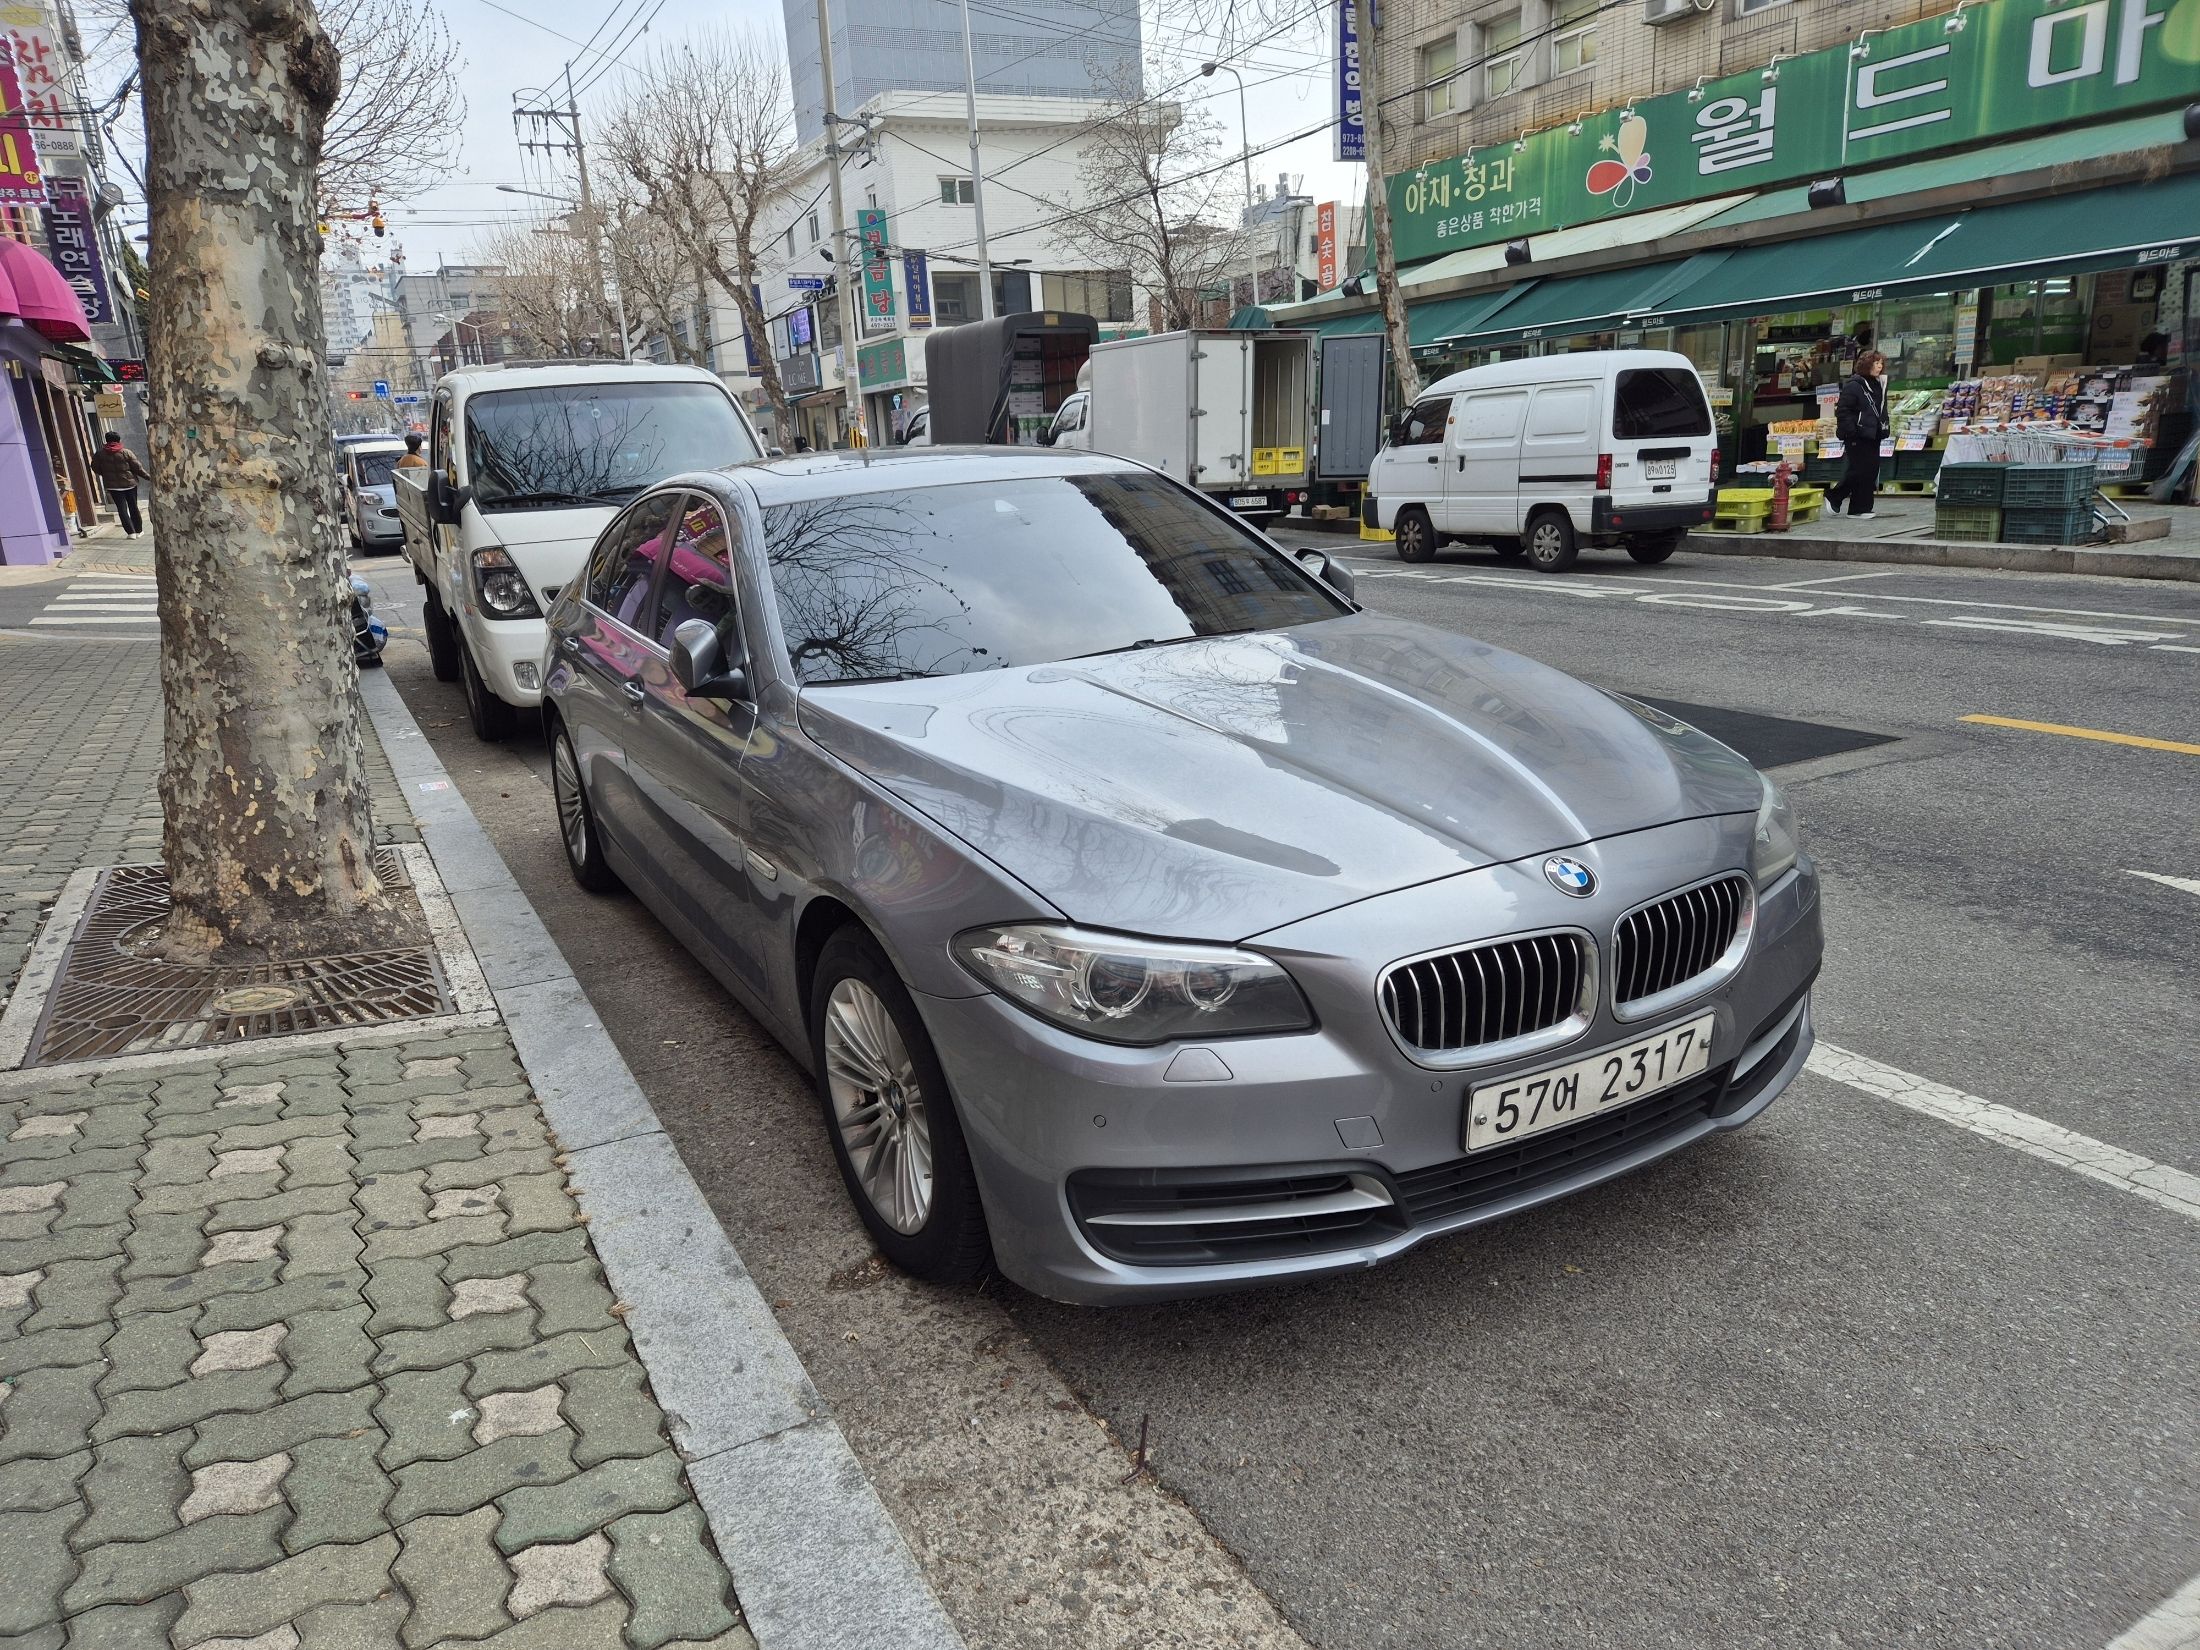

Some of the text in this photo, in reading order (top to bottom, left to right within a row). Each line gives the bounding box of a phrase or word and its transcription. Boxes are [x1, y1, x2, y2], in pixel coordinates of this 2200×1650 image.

[1436, 197, 1541, 238] 좋은상품 착한가격
[2138, 246, 2181, 263] 월드마트
[1852, 289, 1883, 301] 월드마트
[1495, 1028, 1696, 1134] 57어 2317
